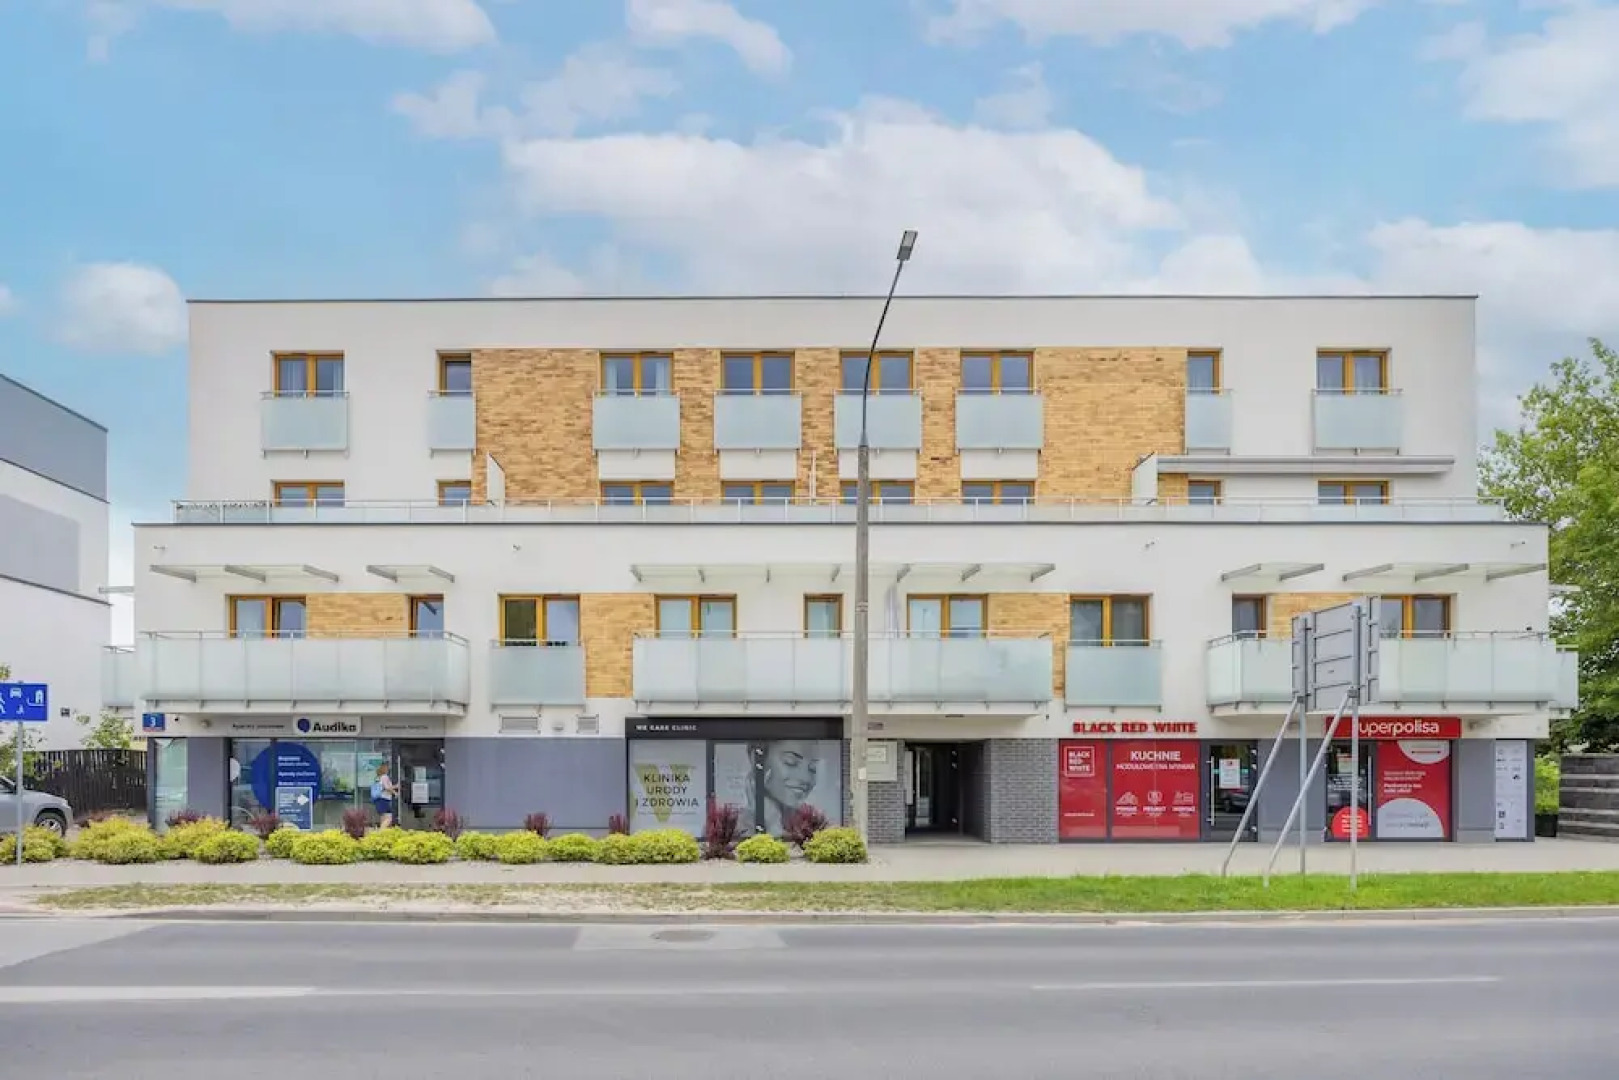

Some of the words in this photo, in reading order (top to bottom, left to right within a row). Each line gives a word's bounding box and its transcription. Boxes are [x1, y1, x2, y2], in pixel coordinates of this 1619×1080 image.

[312, 721, 357, 733] Audika
[1073, 722, 1117, 733] BLACK
[1122, 722, 1149, 733] RED
[1154, 722, 1197, 733] WHITE
[1352, 719, 1440, 736] uperpolisa
[1130, 750, 1181, 761] KUCHNIE
[643, 773, 690, 783] KLINIKA
[646, 786, 688, 795] URODY
[642, 798, 699, 807] ZDROWIA
